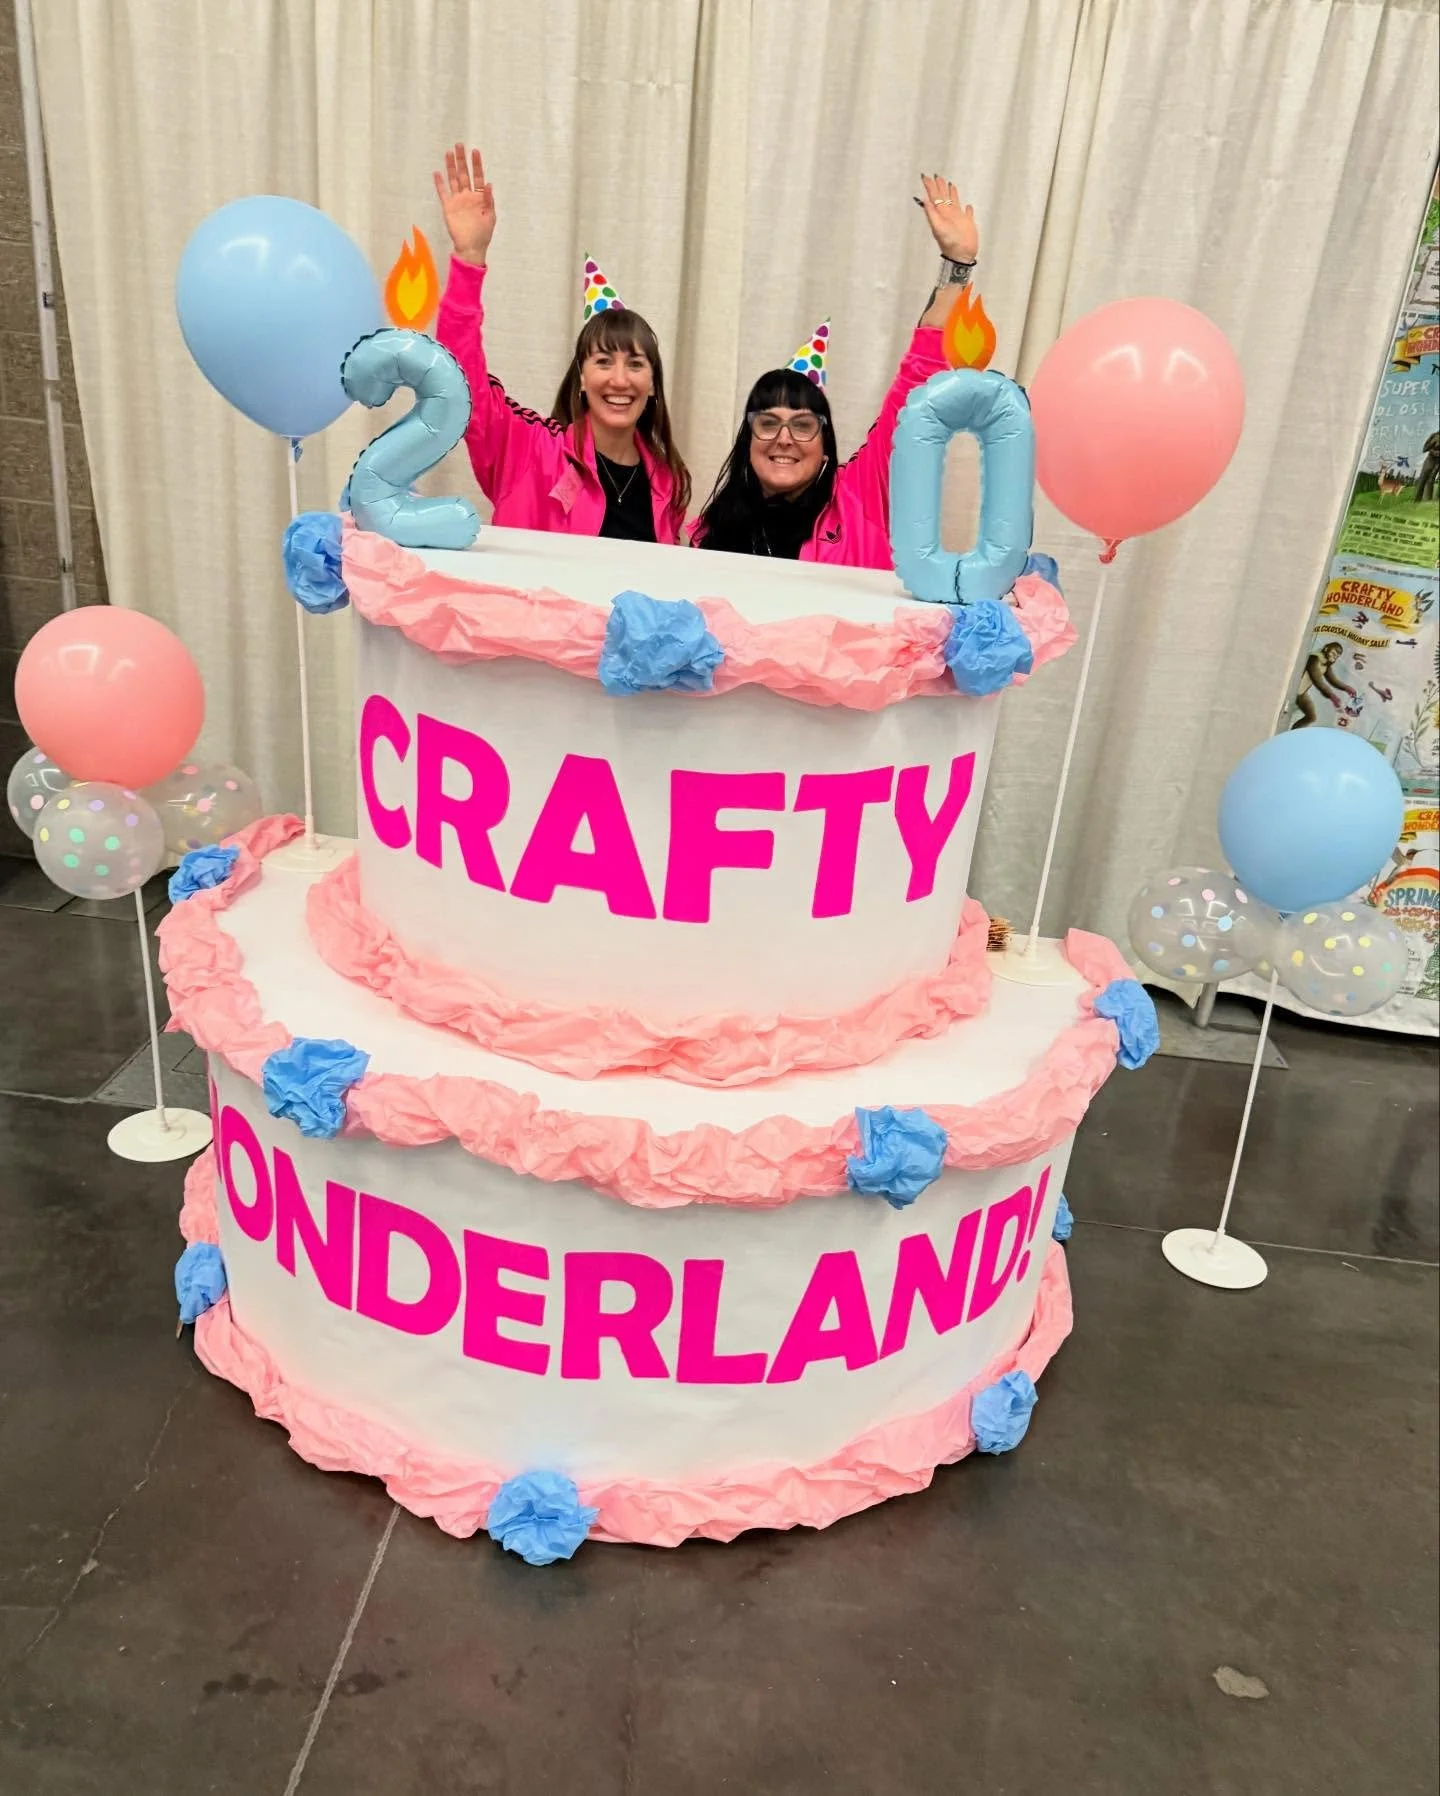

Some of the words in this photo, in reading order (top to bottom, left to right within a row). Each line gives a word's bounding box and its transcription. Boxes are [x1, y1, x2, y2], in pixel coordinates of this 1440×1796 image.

[1379, 380, 1430, 398] SUPER
[1341, 581, 1396, 601] CRAFTY
[1326, 592, 1404, 617] WONDERLAND
[1321, 624, 1347, 636] COLOSSAL
[360, 694, 976, 924] CRAFTY
[210, 1076, 1053, 1385] ONDERLAND!
